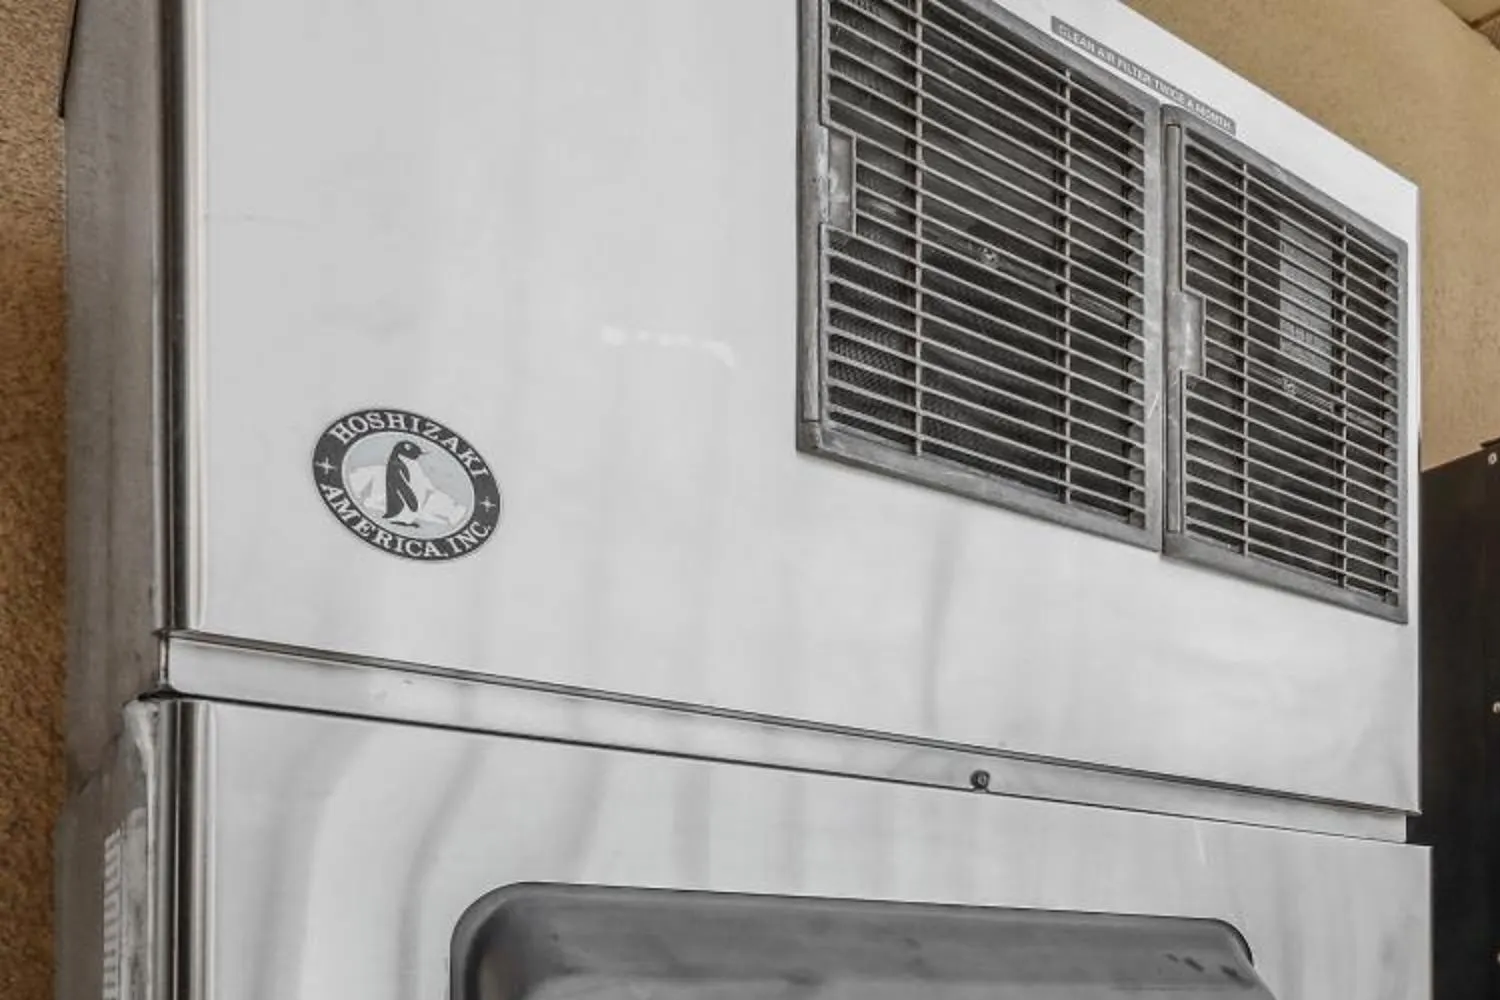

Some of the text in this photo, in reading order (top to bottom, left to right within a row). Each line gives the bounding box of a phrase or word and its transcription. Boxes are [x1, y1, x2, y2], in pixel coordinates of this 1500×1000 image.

[1059, 23, 1095, 52] CLEAN
[1097, 47, 1116, 65] AIR
[1116, 56, 1151, 86] FILTER
[1154, 78, 1185, 107] TWICE
[1195, 102, 1231, 130] MONTH
[329, 411, 489, 478] HOSHIZAKI
